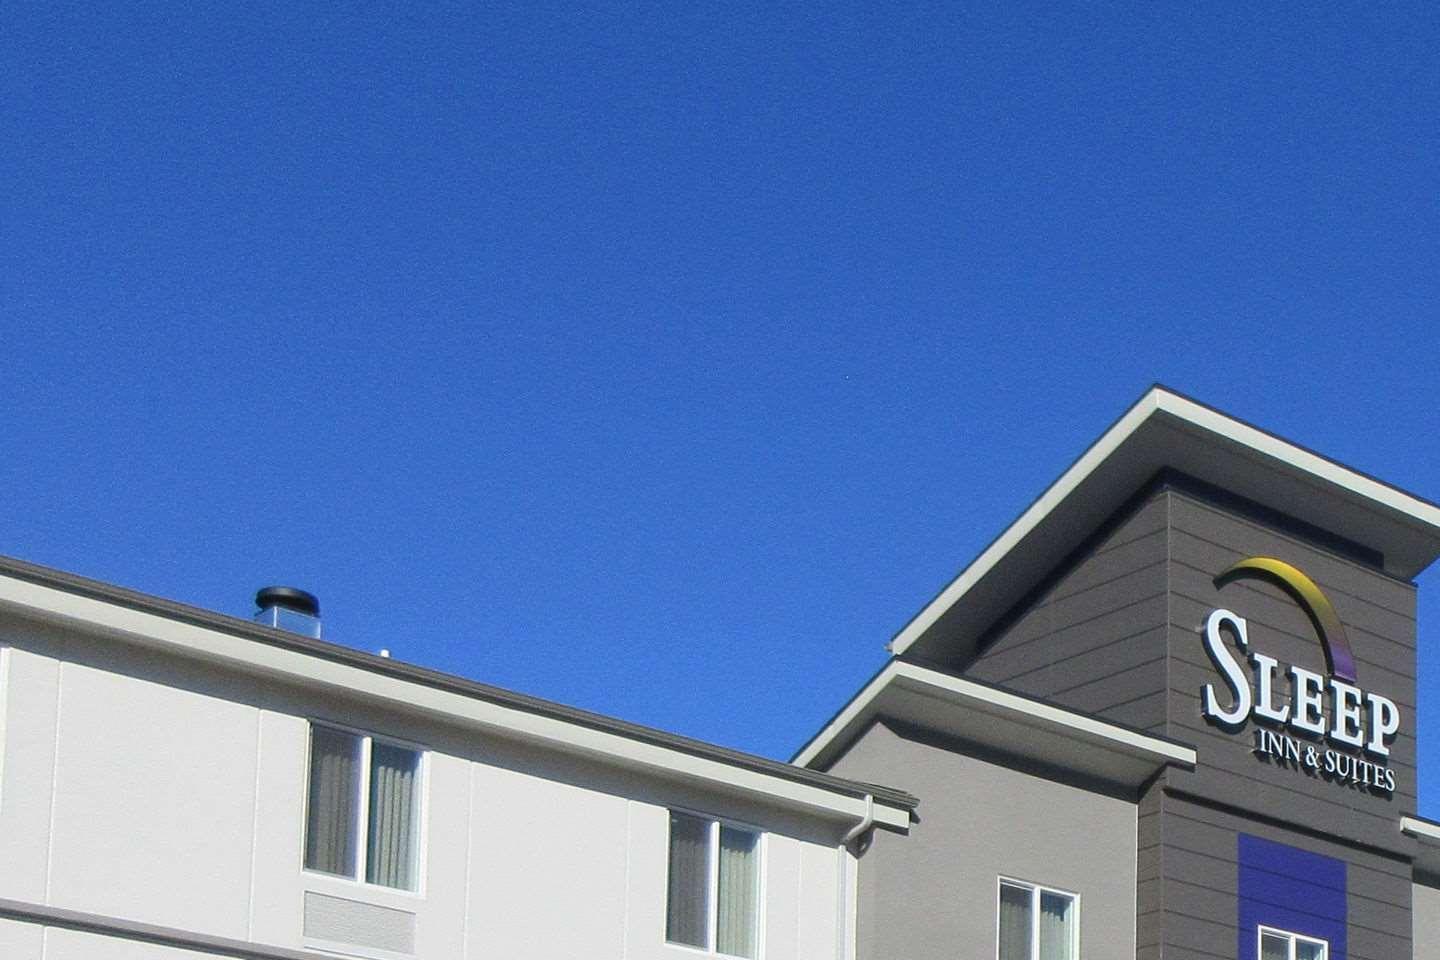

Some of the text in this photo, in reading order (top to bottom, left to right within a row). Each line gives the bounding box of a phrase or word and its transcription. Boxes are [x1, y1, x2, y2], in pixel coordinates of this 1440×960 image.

[1205, 608, 1400, 757] SLEEP
[1256, 728, 1397, 793] INN & SUITES
